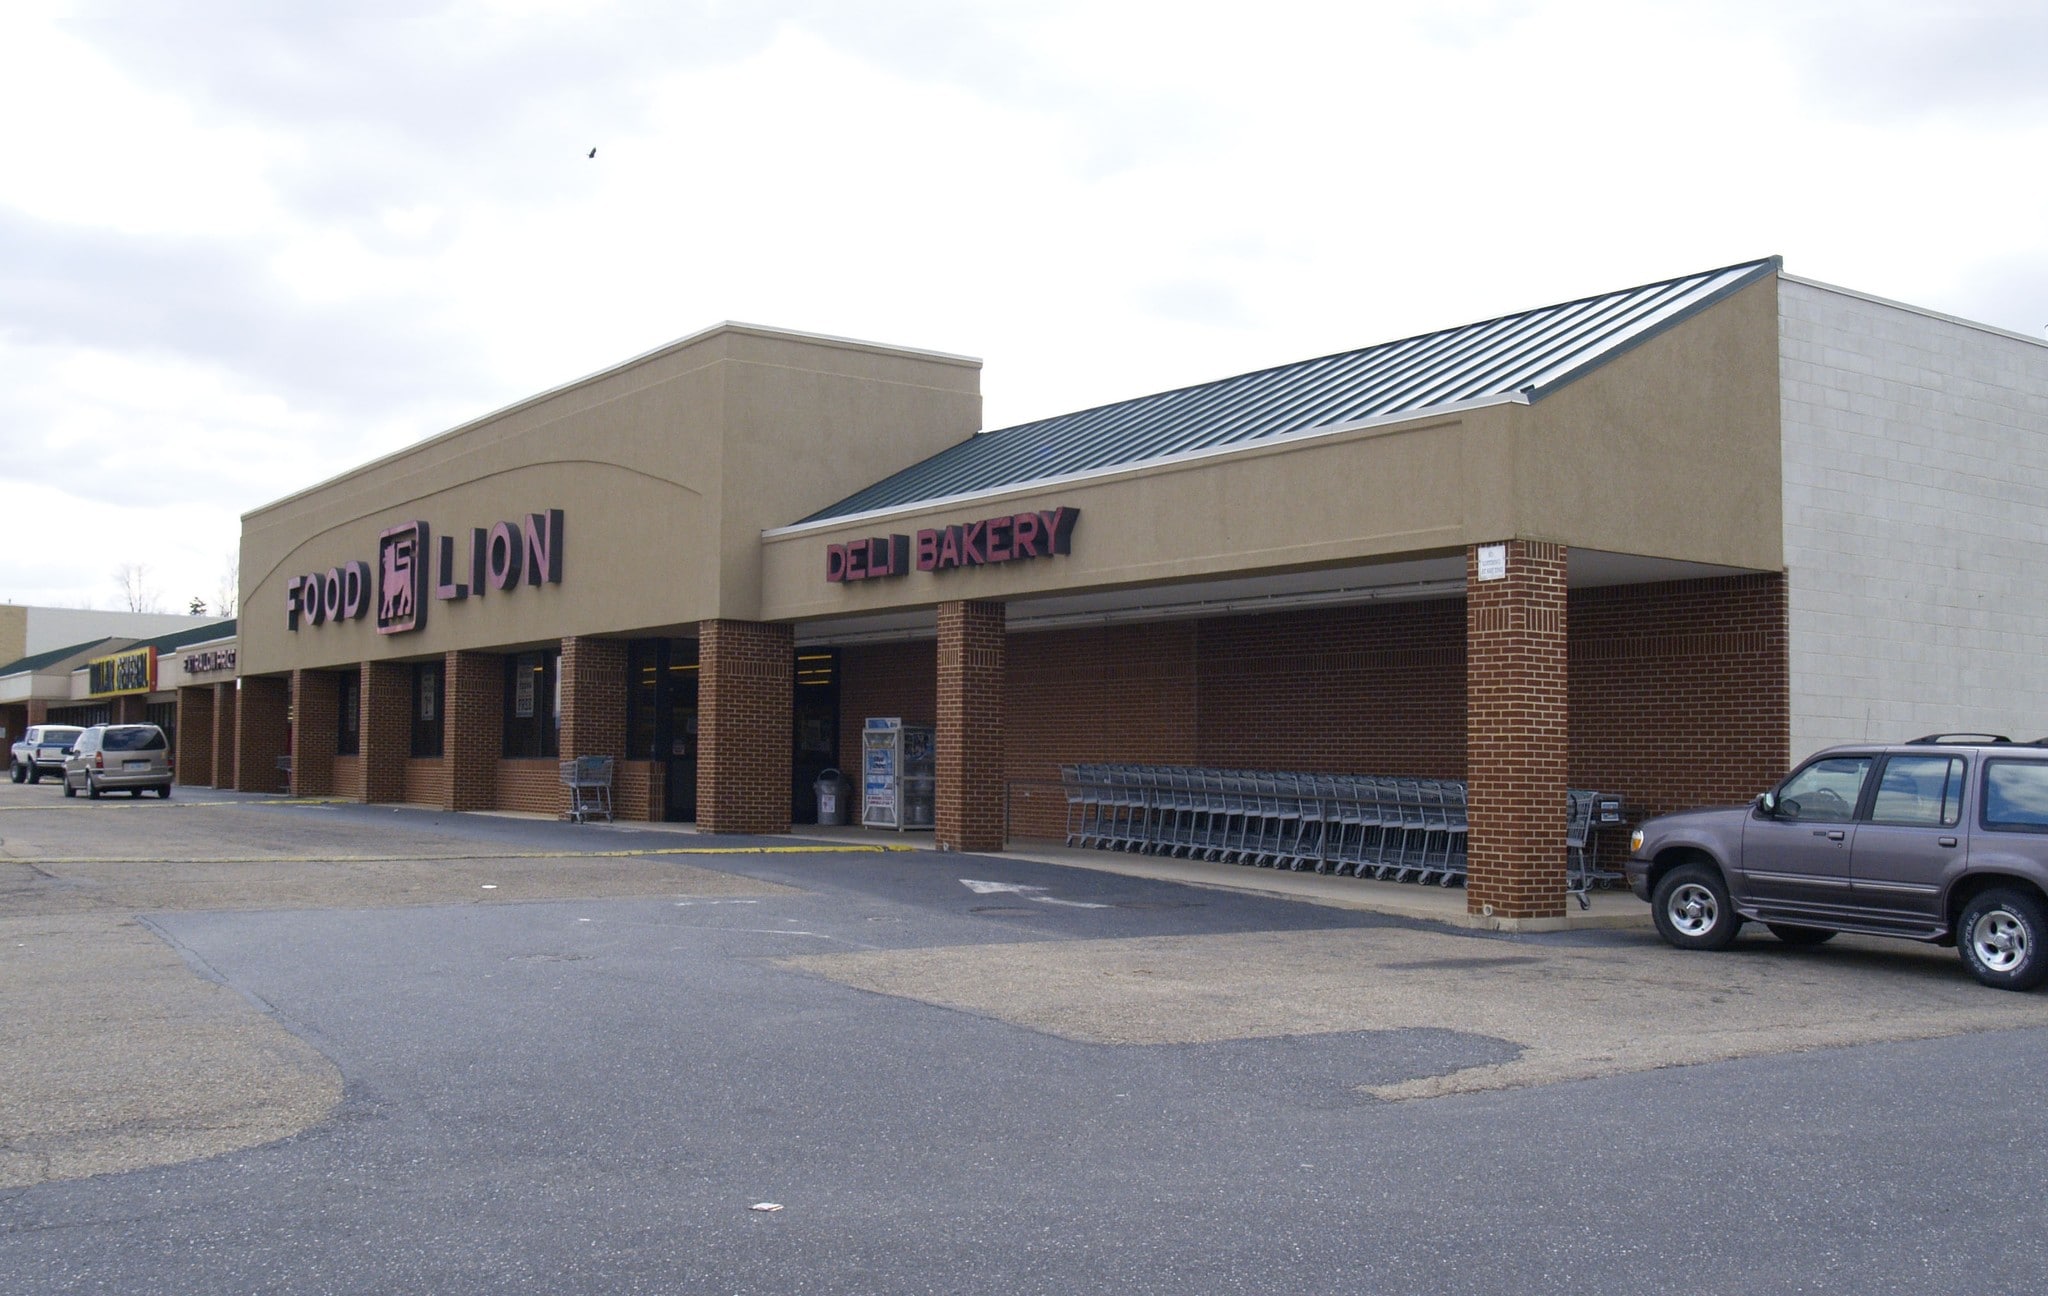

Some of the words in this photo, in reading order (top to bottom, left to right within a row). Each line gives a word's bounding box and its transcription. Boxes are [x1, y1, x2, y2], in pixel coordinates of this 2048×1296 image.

[287, 560, 371, 631] FOOD
[436, 509, 564, 600] LION
[826, 534, 910, 583] DELI
[916, 506, 1080, 572] BAKERY
